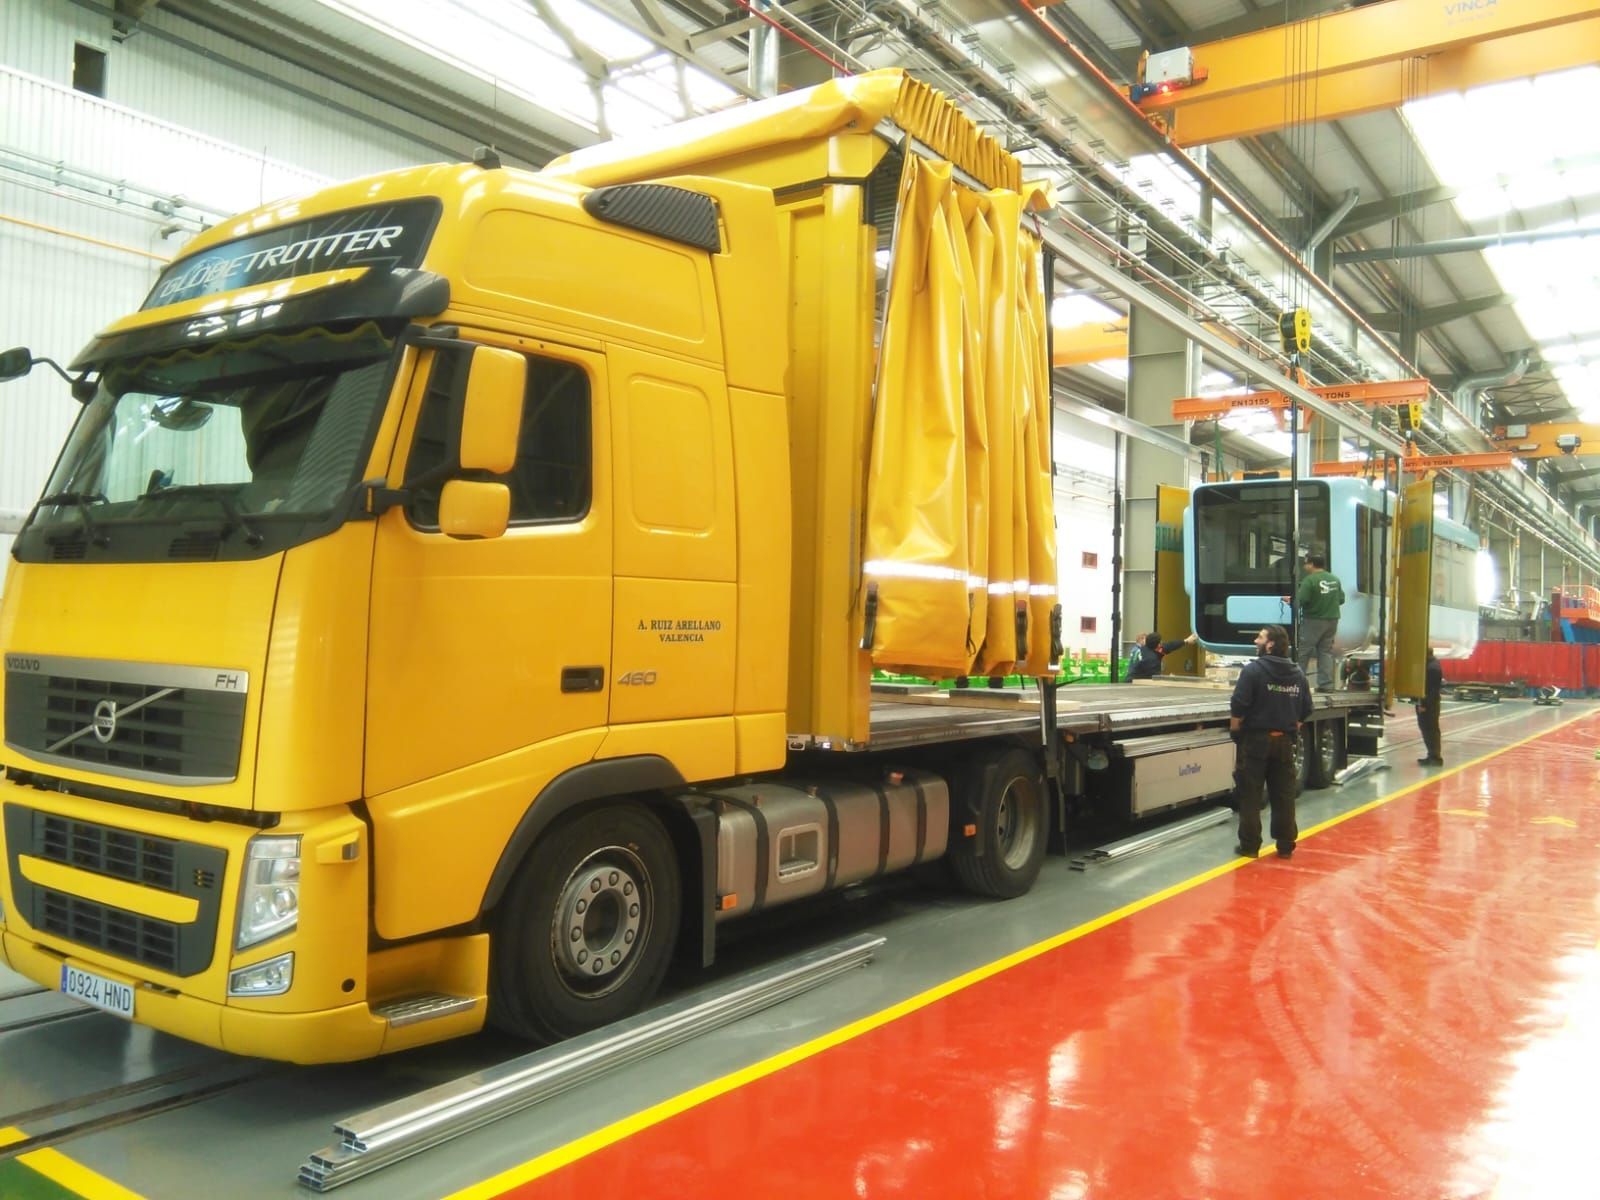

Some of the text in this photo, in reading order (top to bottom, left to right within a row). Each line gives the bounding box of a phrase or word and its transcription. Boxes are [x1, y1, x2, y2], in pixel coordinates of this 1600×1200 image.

[160, 226, 403, 298] GLOBETROTTER
[1325, 391, 1351, 399] TONS
[638, 619, 721, 630] A. RUIZ ARELLANO
[659, 633, 704, 642] VALENCIA
[7, 657, 40, 671] VOLVO
[215, 674, 239, 689] FH
[617, 670, 657, 686] 460
[69, 970, 131, 1012] 0924 HND
